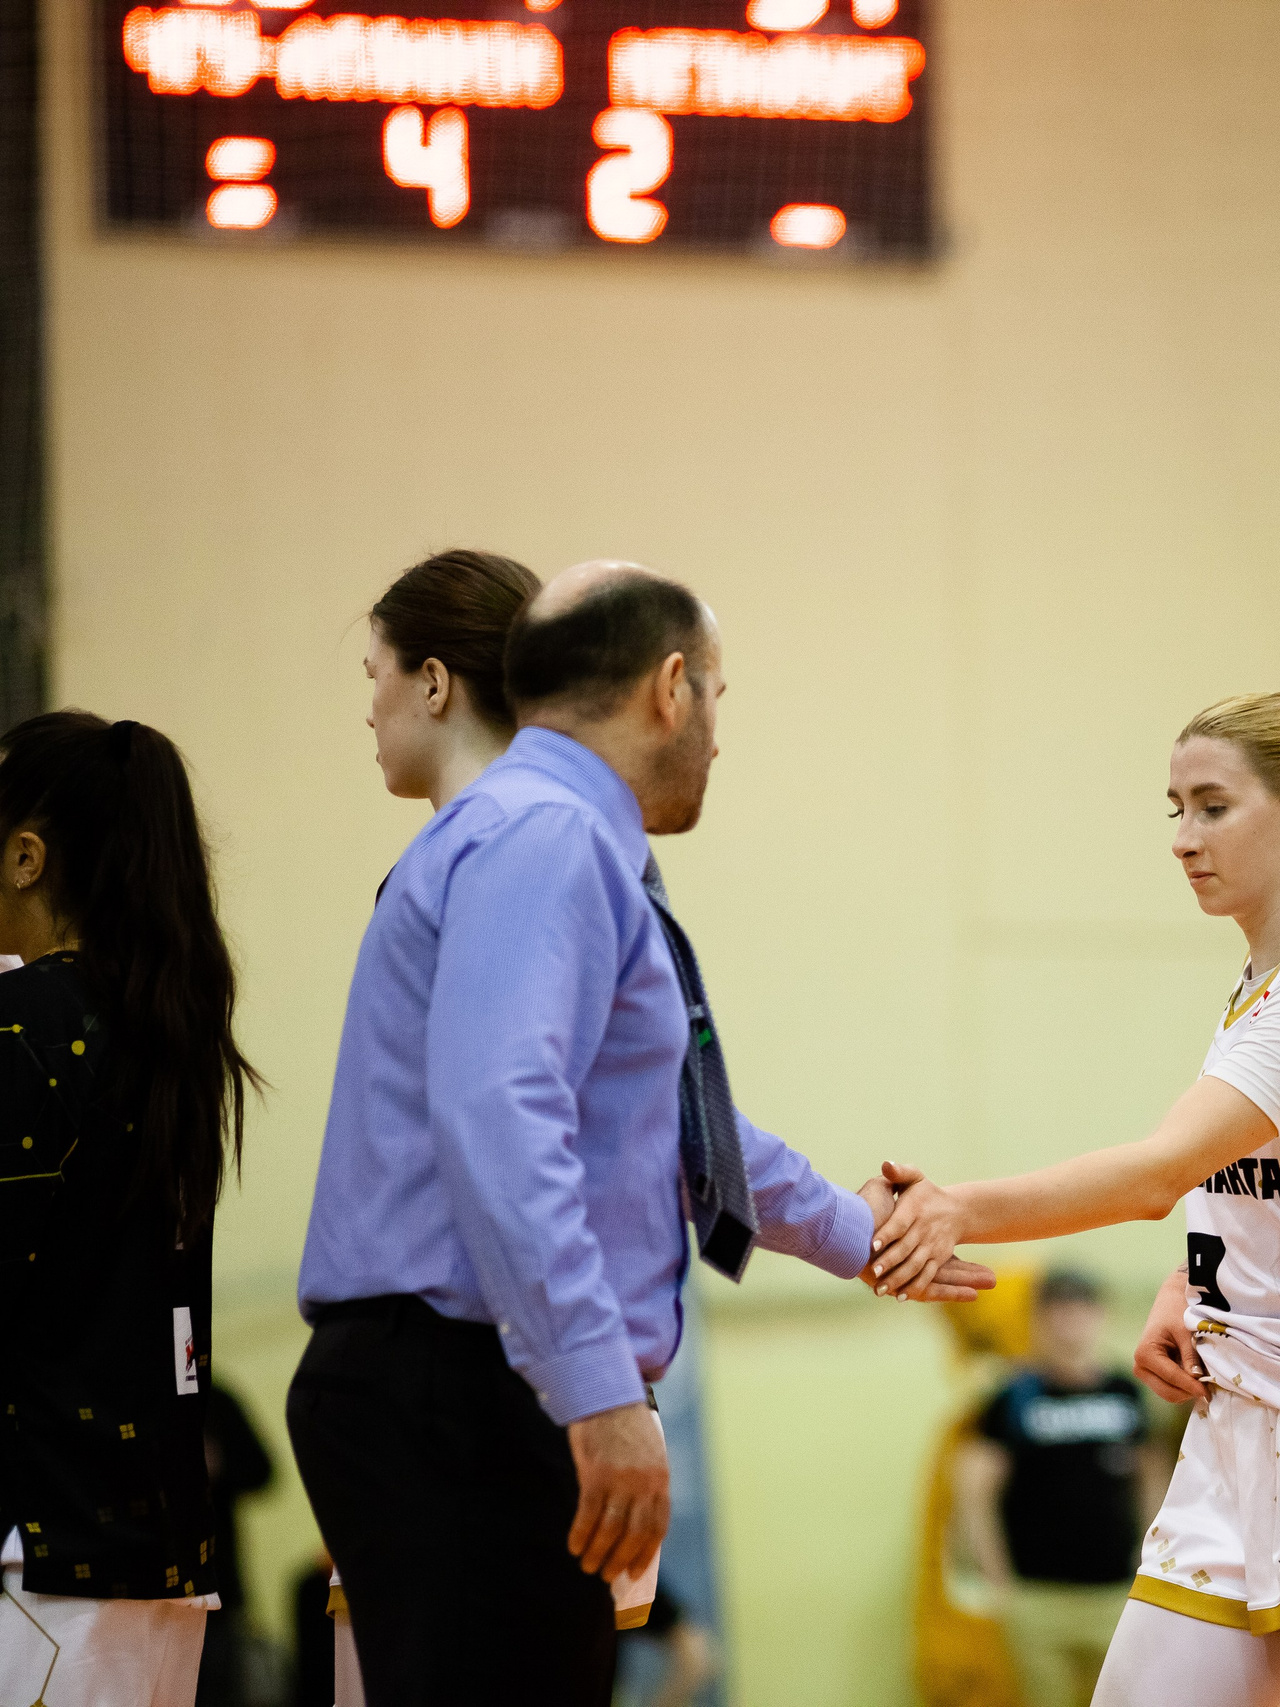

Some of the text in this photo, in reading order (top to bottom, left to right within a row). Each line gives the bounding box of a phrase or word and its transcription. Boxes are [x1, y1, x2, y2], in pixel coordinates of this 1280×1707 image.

[382, 105, 470, 228] 4
[586, 106, 673, 243] 2
[1187, 1231, 1231, 1312] 9
